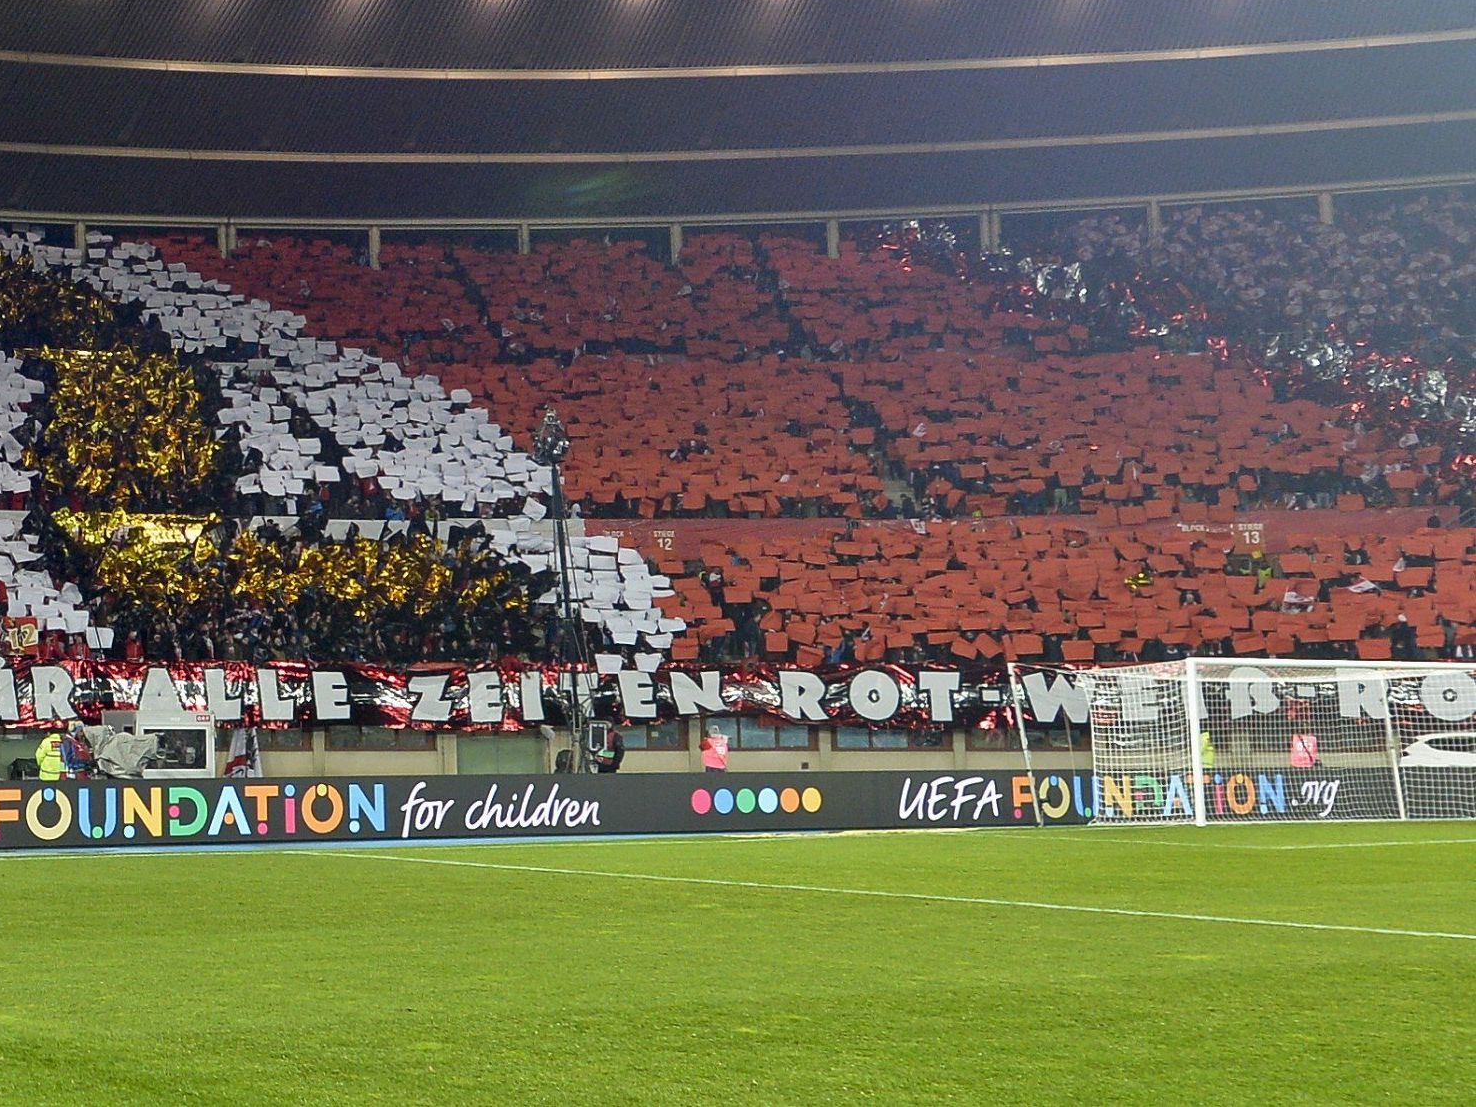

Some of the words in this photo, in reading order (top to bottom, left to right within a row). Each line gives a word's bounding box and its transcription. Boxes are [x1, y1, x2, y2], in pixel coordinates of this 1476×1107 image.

[657, 538, 673, 551] 12
[1243, 531, 1260, 544] 13
[4, 623, 39, 650] 12
[138, 667, 350, 721] ALLE
[410, 669, 727, 722] ZEITEN
[400, 781, 453, 838] for
[465, 782, 601, 828] children
[899, 776, 1003, 821] UEFA
